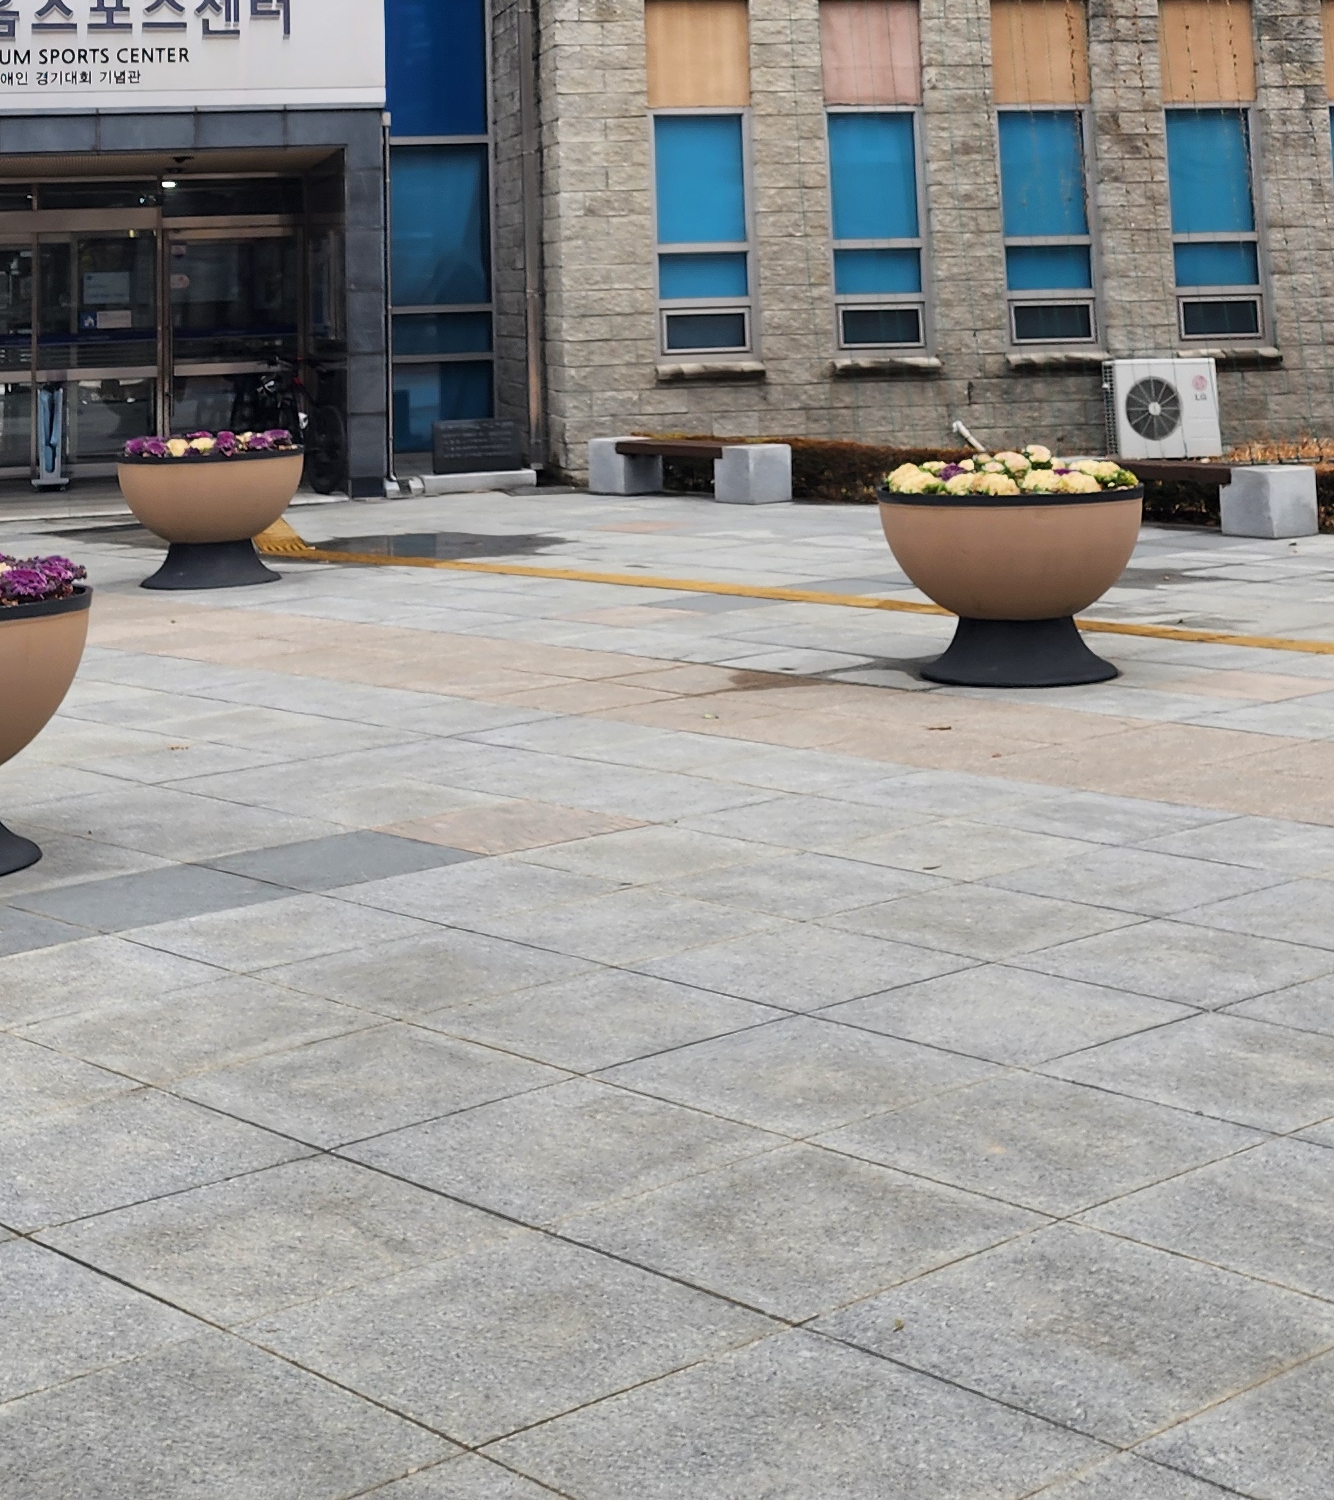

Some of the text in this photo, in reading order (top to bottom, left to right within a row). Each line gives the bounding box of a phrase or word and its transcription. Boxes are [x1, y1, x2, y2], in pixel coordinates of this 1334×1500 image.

[39, 48, 109, 65] SPORTS
[117, 47, 190, 63] CENTER
[36, 70, 92, 85] 경기대회
[99, 69, 141, 84] 기념관
